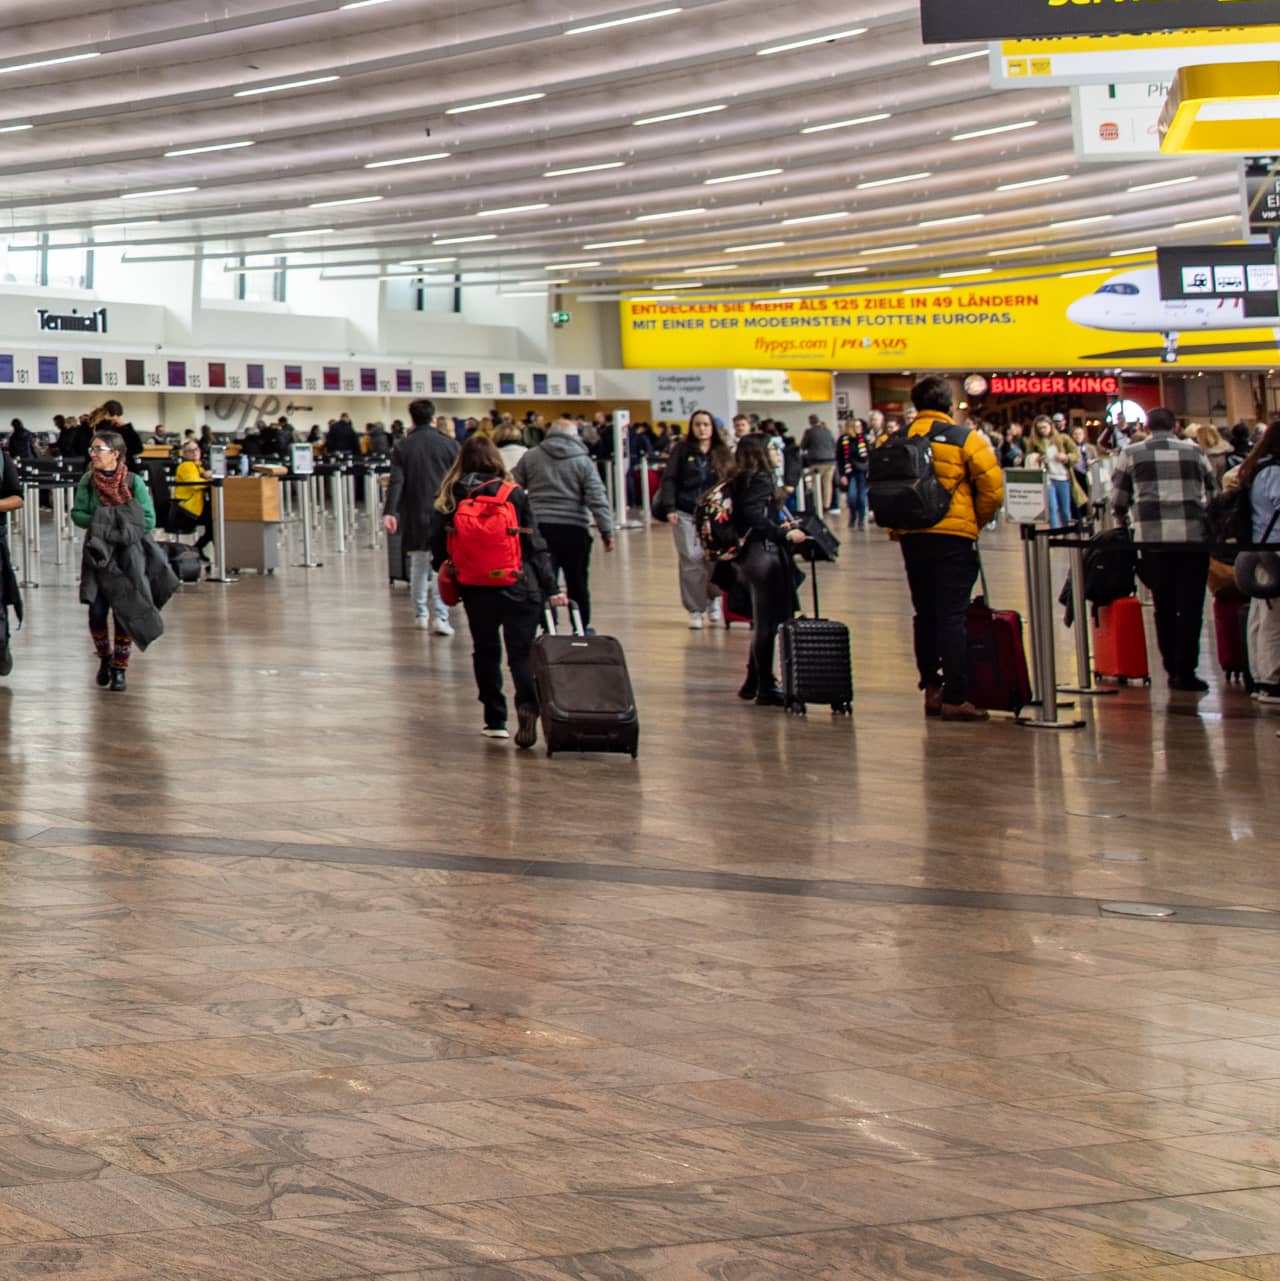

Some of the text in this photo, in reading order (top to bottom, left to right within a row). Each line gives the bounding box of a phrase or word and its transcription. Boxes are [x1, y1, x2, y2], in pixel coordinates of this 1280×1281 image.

[632, 293, 1039, 315] ENTDECKEN SIE MEHR ALS 125 ZIELE IN 49 LÄNDERN
[99, 308, 107, 333] 1
[633, 313, 1016, 330] MIT EINER DER MODERNSTEN FLOTTEN EUROPAS.
[991, 378, 1065, 393] BURGER
